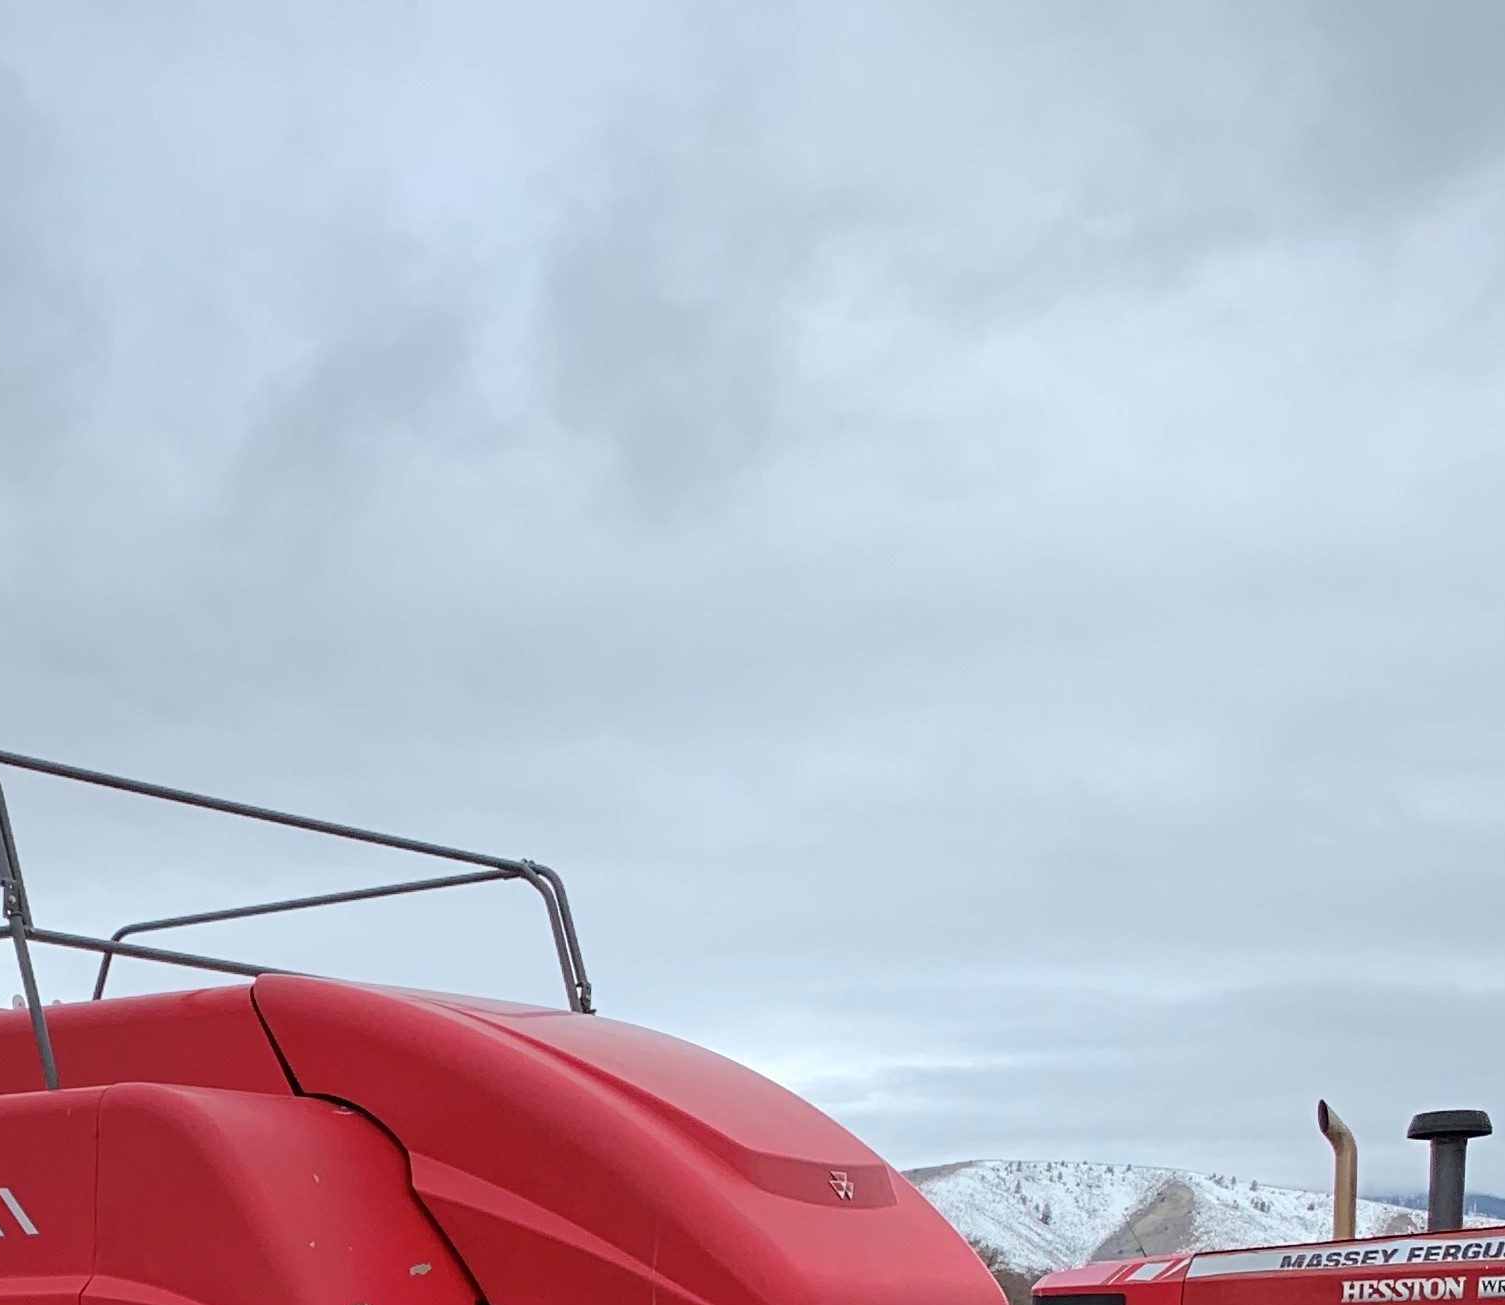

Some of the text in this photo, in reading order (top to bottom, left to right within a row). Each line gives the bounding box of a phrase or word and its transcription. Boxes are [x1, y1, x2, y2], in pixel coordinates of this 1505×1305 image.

[1279, 1240, 1505, 1269] MASSEY FERGU
[1340, 1275, 1468, 1303] HESSTON
